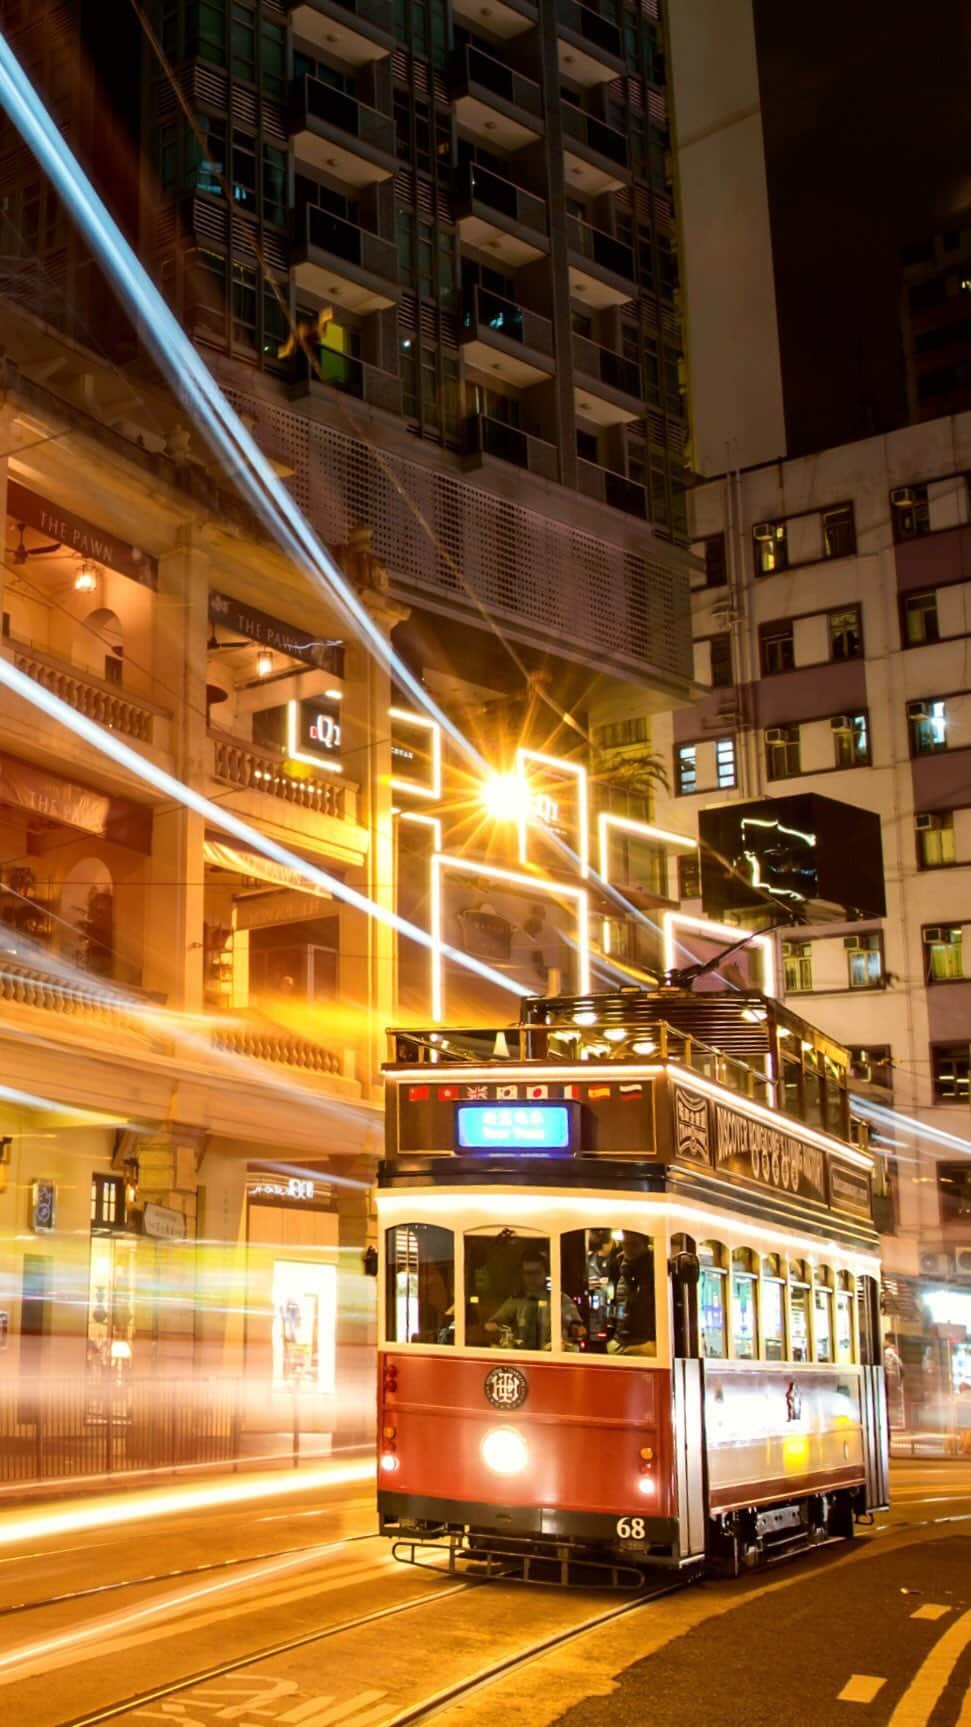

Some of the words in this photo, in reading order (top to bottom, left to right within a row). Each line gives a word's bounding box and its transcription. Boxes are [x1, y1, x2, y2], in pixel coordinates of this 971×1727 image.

[40, 511, 66, 539] THE
[73, 528, 113, 561] PAWN
[239, 615, 262, 637] THE
[616, 1516, 646, 1540] 68
